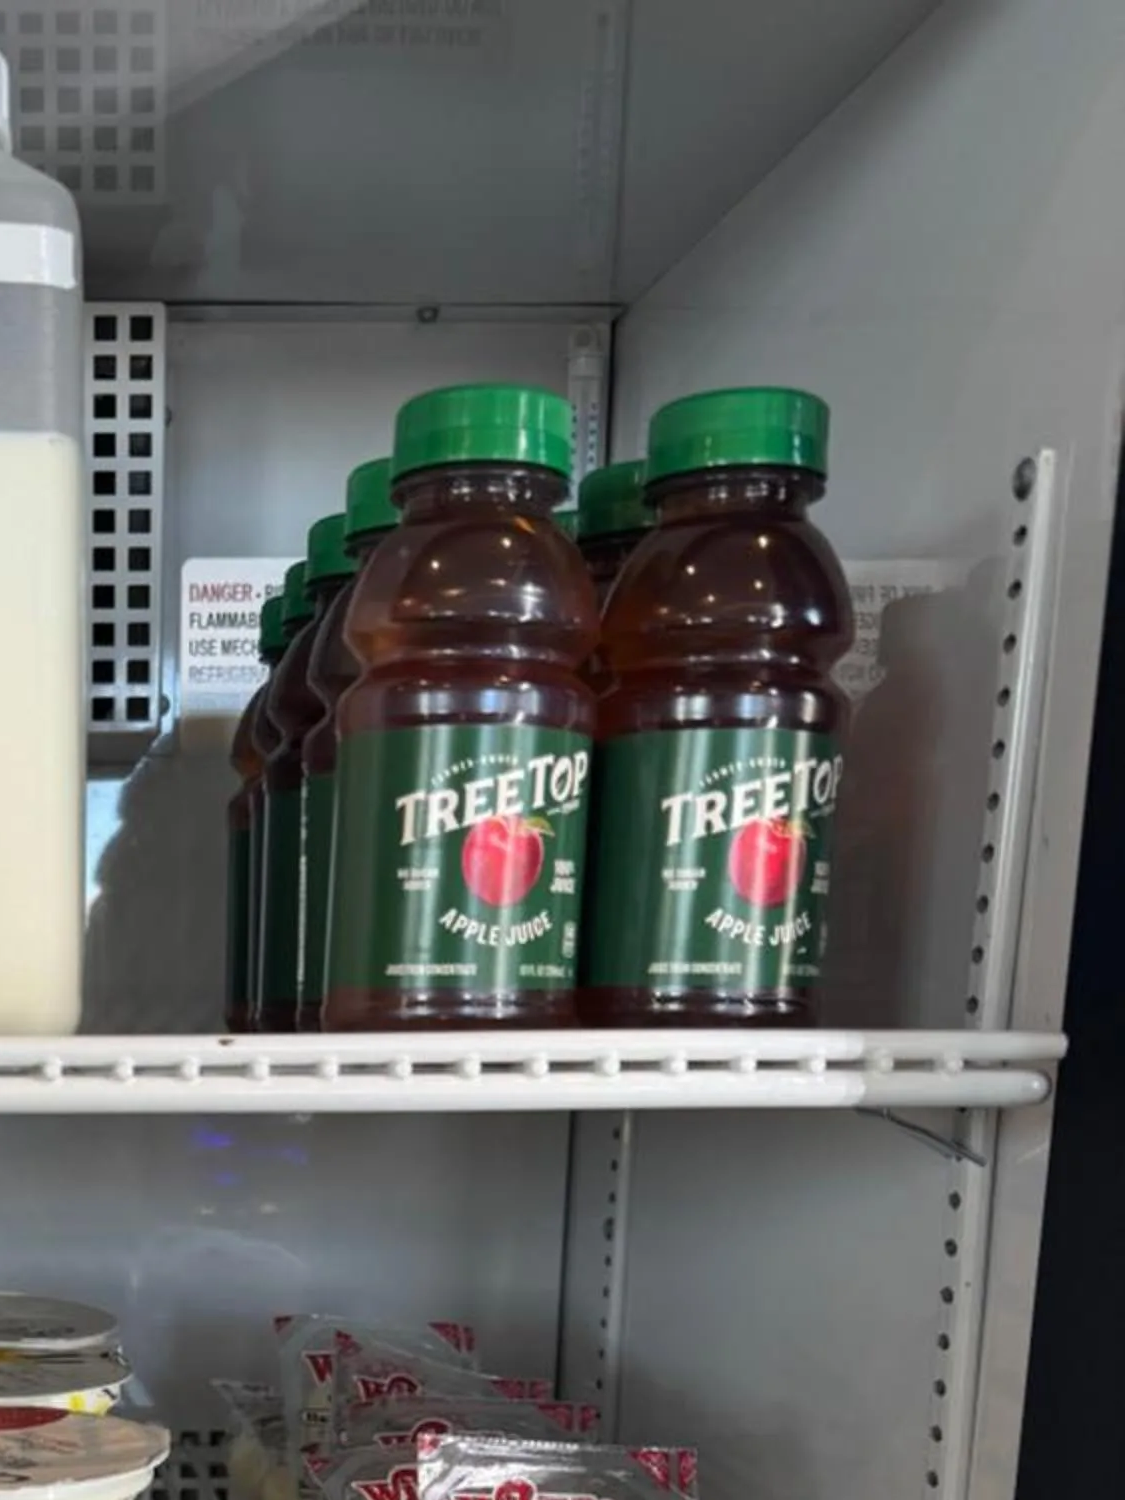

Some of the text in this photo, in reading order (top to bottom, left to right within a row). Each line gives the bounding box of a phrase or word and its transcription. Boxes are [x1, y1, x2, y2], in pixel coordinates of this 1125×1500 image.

[188, 583, 252, 602] DANGER
[188, 612, 260, 630] FLAMMAB
[395, 768, 525, 846] TREE
[527, 751, 588, 809] TOP
[660, 772, 792, 847] TREE
[793, 753, 844, 812] TOP
[438, 907, 553, 947] APPLE JUICE
[704, 907, 813, 947] APPLE JUICE
